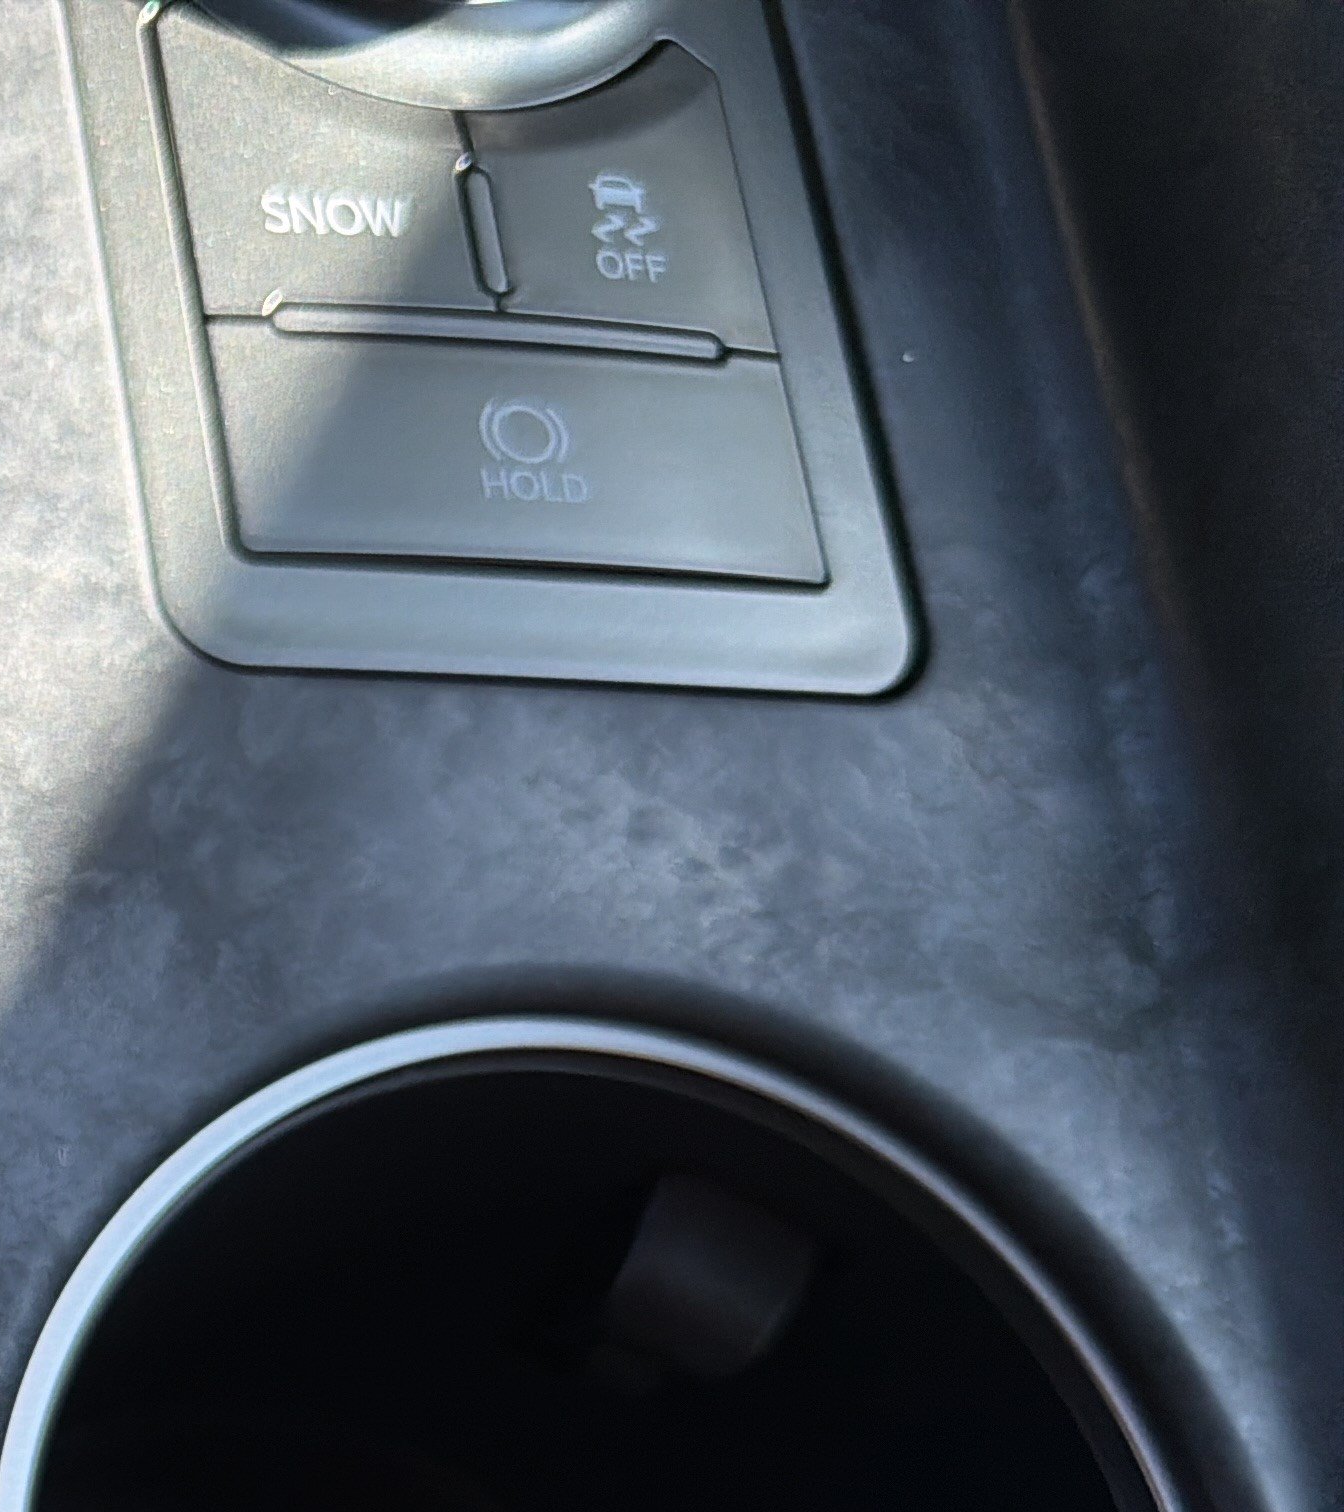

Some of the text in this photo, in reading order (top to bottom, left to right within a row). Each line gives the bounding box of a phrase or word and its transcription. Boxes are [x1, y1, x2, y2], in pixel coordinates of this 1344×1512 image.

[261, 187, 411, 237] SNOW
[595, 249, 668, 283] OFF
[480, 467, 591, 504] HOLD
